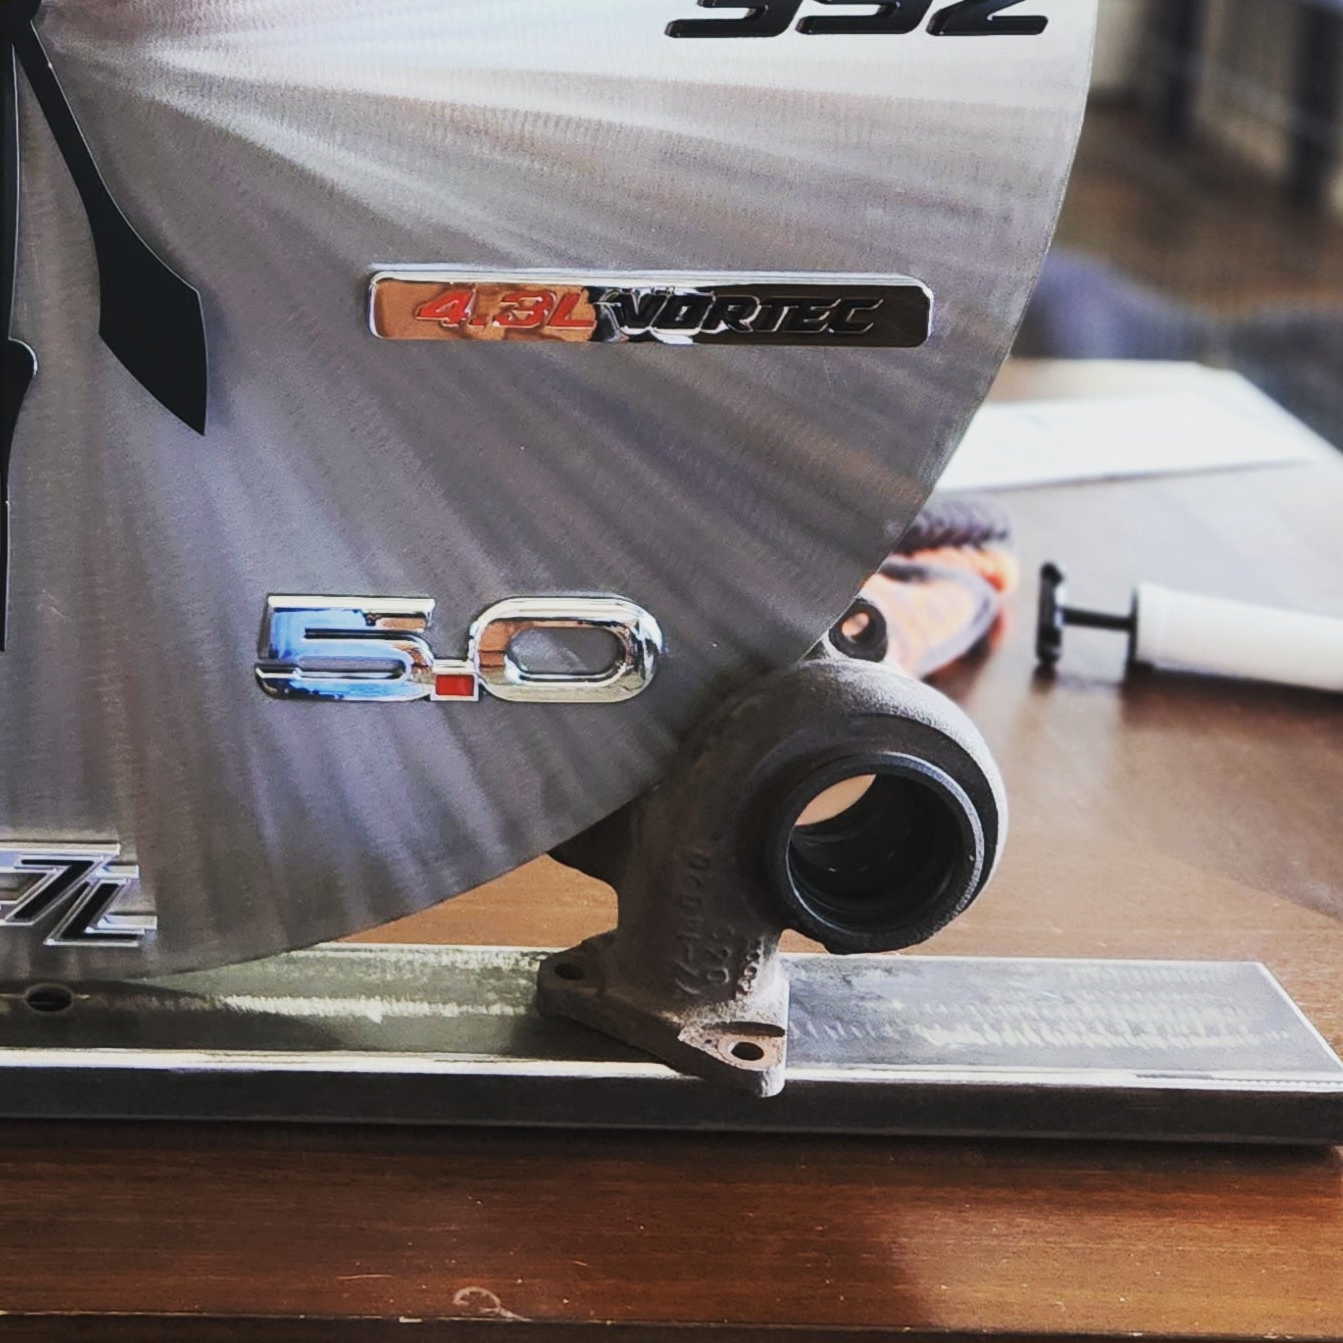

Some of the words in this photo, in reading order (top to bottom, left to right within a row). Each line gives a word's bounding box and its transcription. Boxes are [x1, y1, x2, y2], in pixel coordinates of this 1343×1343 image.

[414, 288, 597, 331] 4.3L
[601, 288, 884, 334] VORTEC
[255, 594, 663, 703] 5.0
